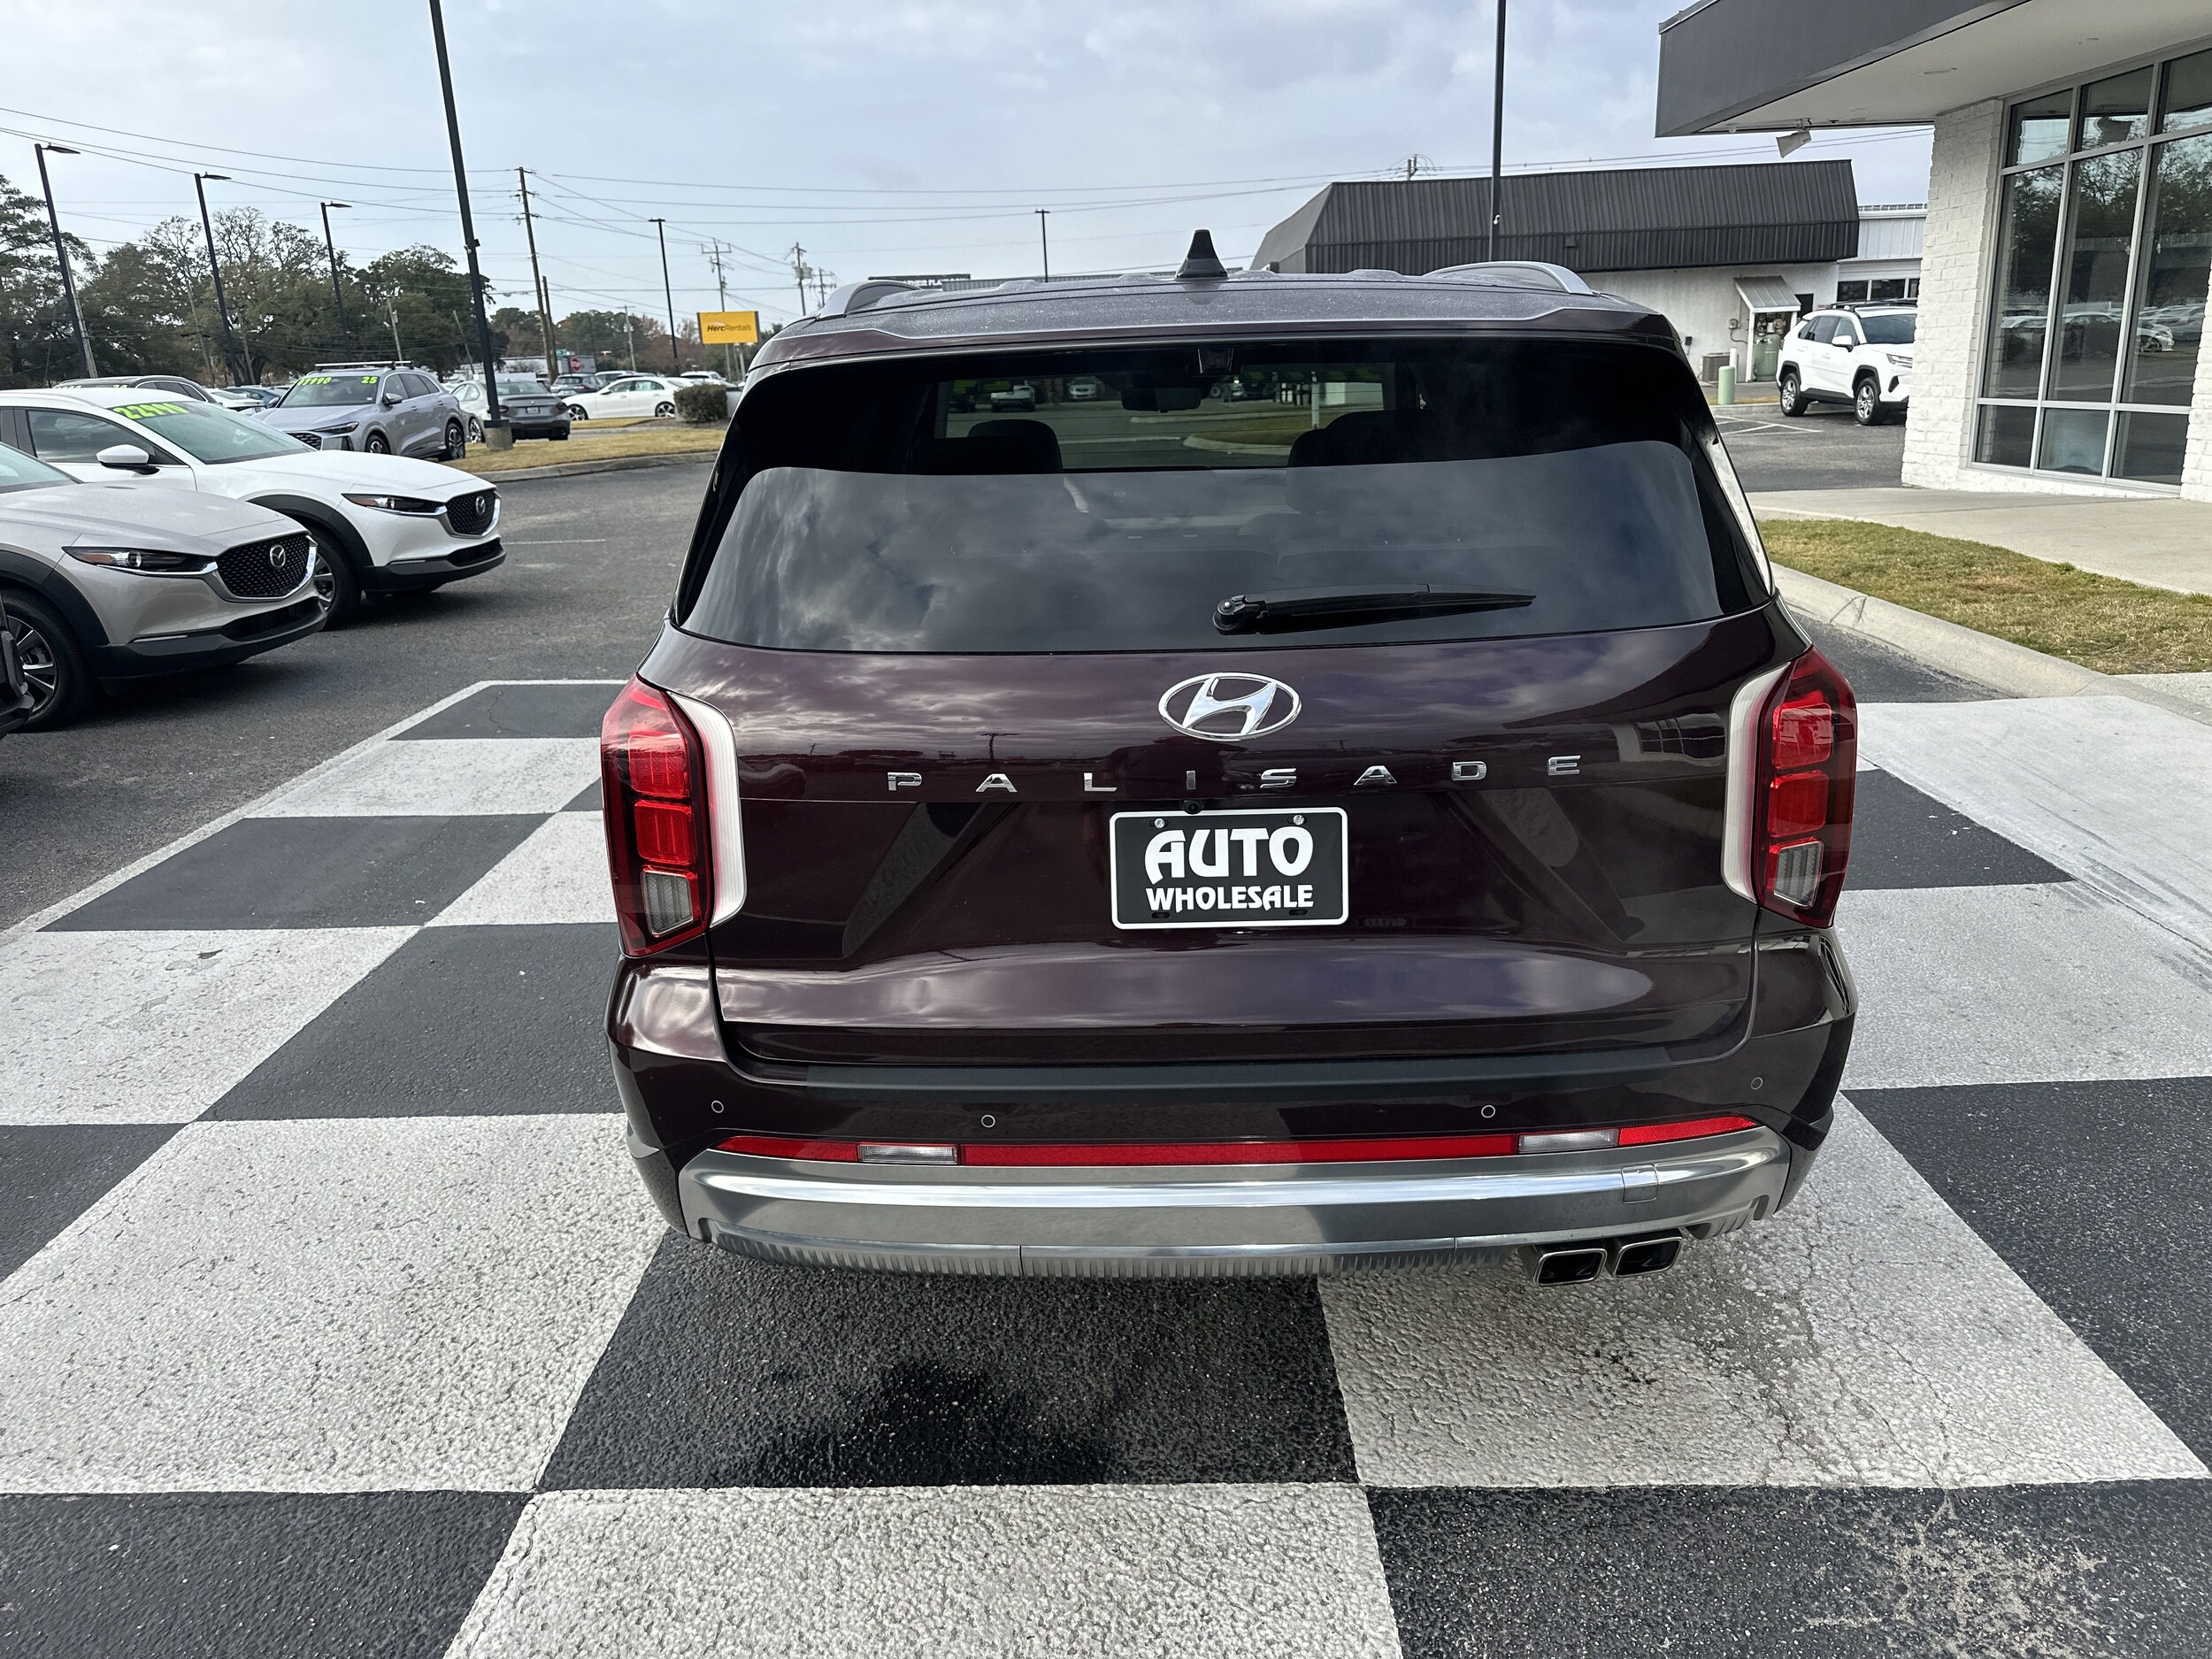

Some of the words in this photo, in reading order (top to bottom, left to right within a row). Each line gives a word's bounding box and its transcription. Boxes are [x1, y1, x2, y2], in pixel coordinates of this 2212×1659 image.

[887, 755, 1581, 793] PALISADE
[1145, 826, 1313, 885] AUTO
[1146, 885, 1314, 913] WHOLESALE
